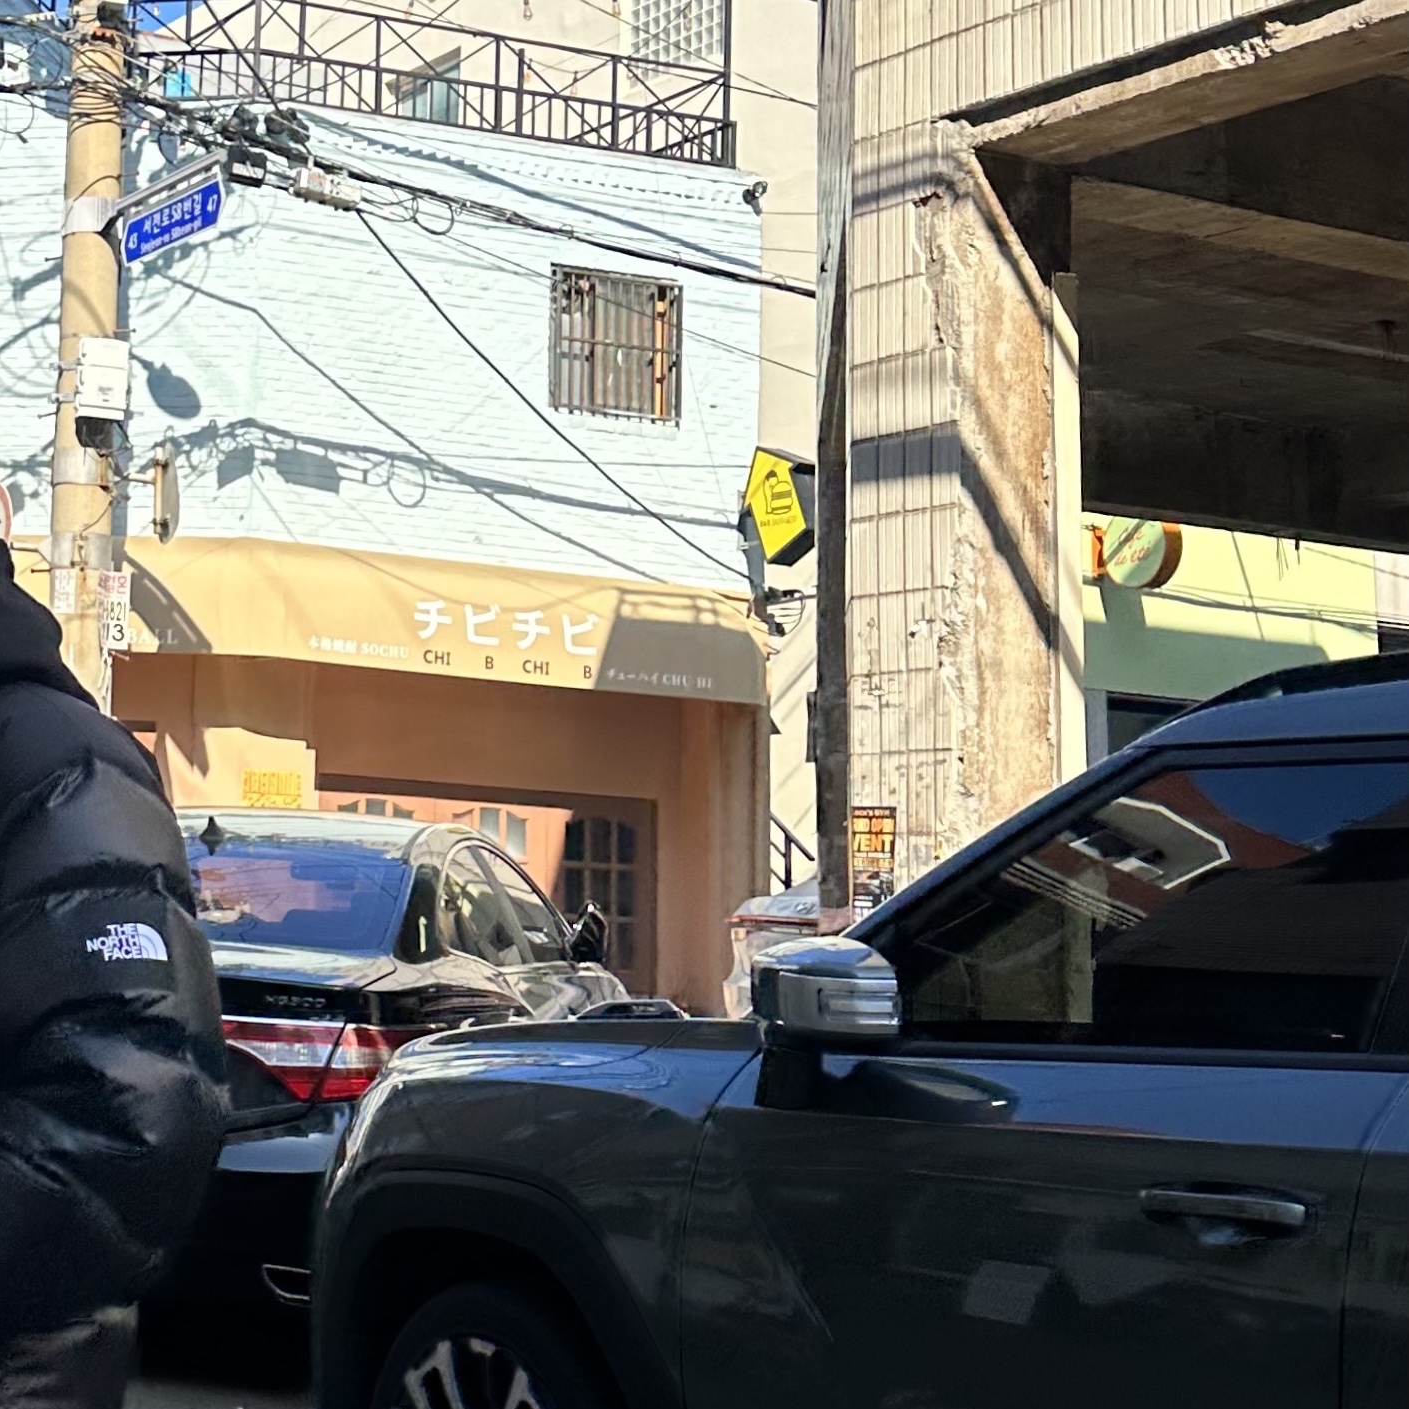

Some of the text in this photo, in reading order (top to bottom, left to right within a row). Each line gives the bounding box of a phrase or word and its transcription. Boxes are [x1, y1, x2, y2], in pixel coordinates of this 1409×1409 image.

[207, 194, 218, 212] 47
[414, 600, 599, 656] チビチビ
[361, 641, 409, 660] SOCHU
[423, 649, 592, 679] CHI B CHI B
[106, 923, 138, 937] THE
[86, 936, 140, 953] NORTH
[103, 947, 143, 961] FACE
